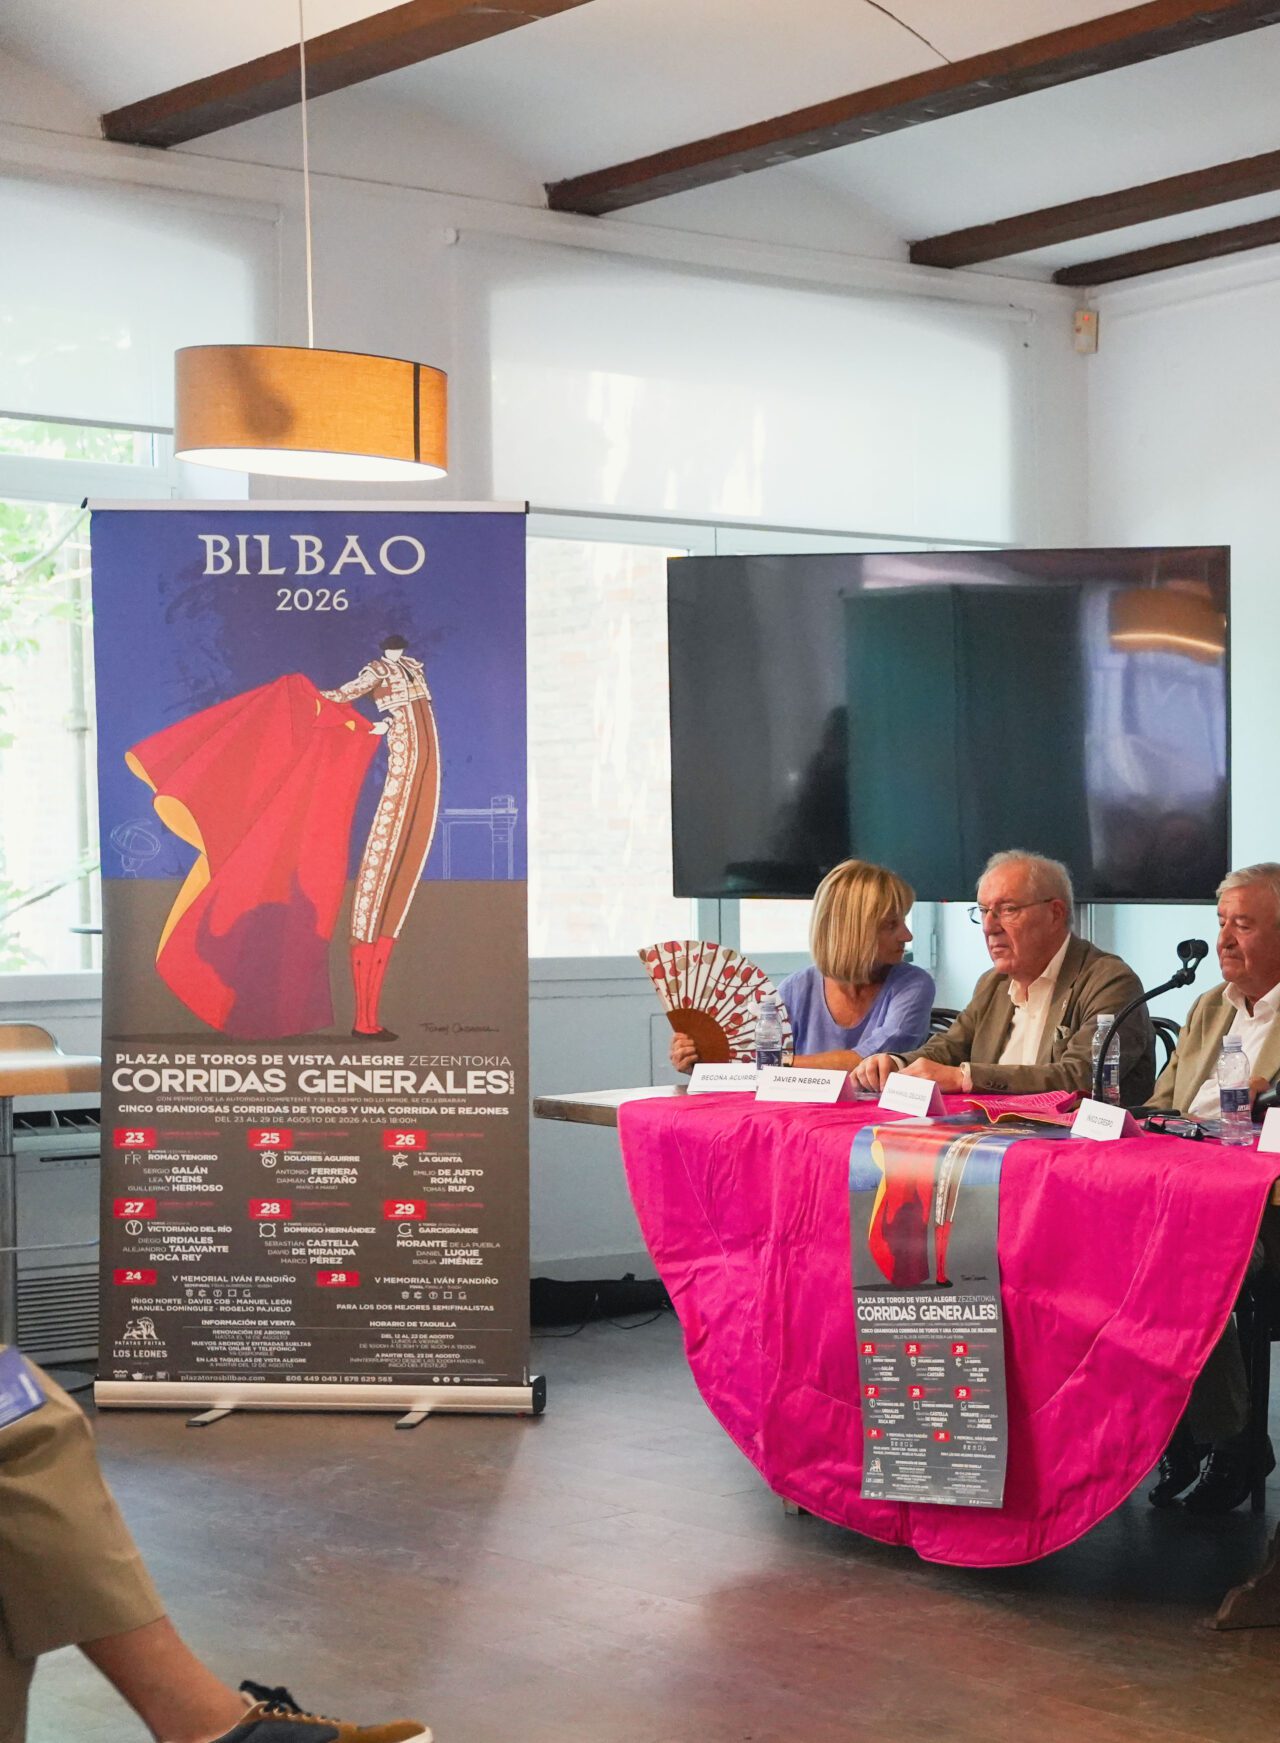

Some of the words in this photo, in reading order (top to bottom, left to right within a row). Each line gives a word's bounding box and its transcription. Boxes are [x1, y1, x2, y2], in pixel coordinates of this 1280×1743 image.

[198, 534, 426, 575] BILBAO
[275, 588, 349, 612] 2026
[116, 1054, 169, 1064] PLAZA
[175, 1054, 196, 1064] DE
[201, 1054, 256, 1065] TOROS
[262, 1055, 283, 1065] DE
[288, 1055, 335, 1065] VISTA
[340, 1055, 404, 1065] ALEGRE
[410, 1056, 511, 1066] ZEZENTOKIA
[112, 1068, 286, 1093] CORRIDAS
[298, 1070, 509, 1094] GENERALES
[156, 1105, 229, 1113] GRANDIOSAS
[310, 1106, 348, 1114] TOROS
[361, 1106, 385, 1114] UNA
[458, 1107, 509, 1115] REJONES
[125, 1132, 145, 1143] 23
[260, 1132, 280, 1144] 25
[395, 1134, 415, 1145] 26
[172, 1166, 208, 1174] GALÁN
[308, 1176, 357, 1184] CASTAÑO
[431, 1175, 466, 1184] ROMÁN
[124, 1202, 144, 1213] 27
[260, 1203, 280, 1214] 28
[395, 1204, 415, 1215] 29
[126, 1272, 142, 1280] 24
[331, 1274, 346, 1282] 28
[857, 1306, 916, 1321] CORRIDAS
[920, 1305, 996, 1320] GENERALES
[113, 1350, 130, 1358] LOS
[134, 1350, 167, 1358] LEONES
